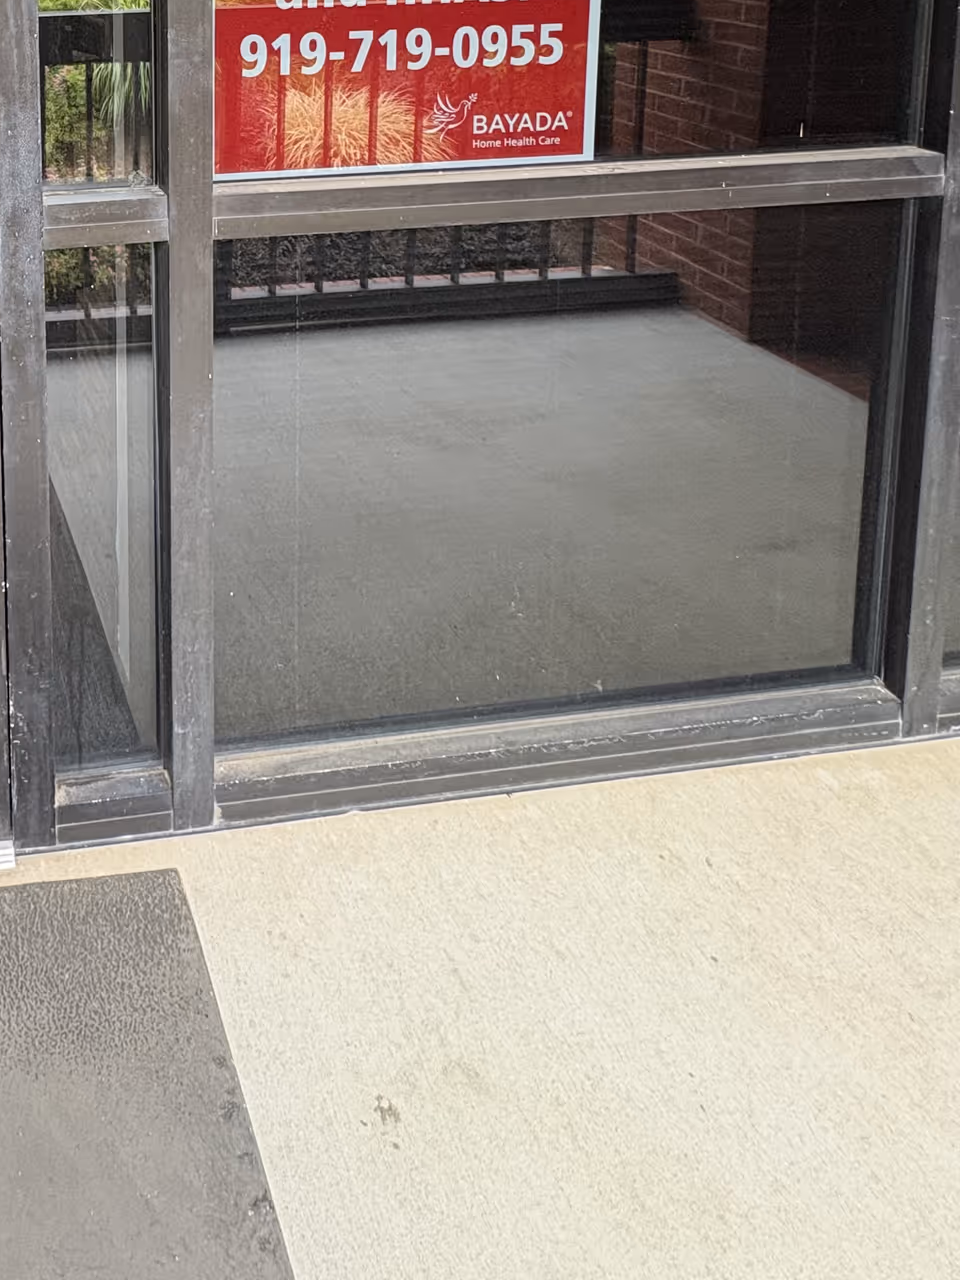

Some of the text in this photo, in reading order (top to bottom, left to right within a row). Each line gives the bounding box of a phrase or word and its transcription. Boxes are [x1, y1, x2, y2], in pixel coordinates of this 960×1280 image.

[239, 22, 564, 78] 919-719-0955
[472, 135, 561, 149] Home Health Care
